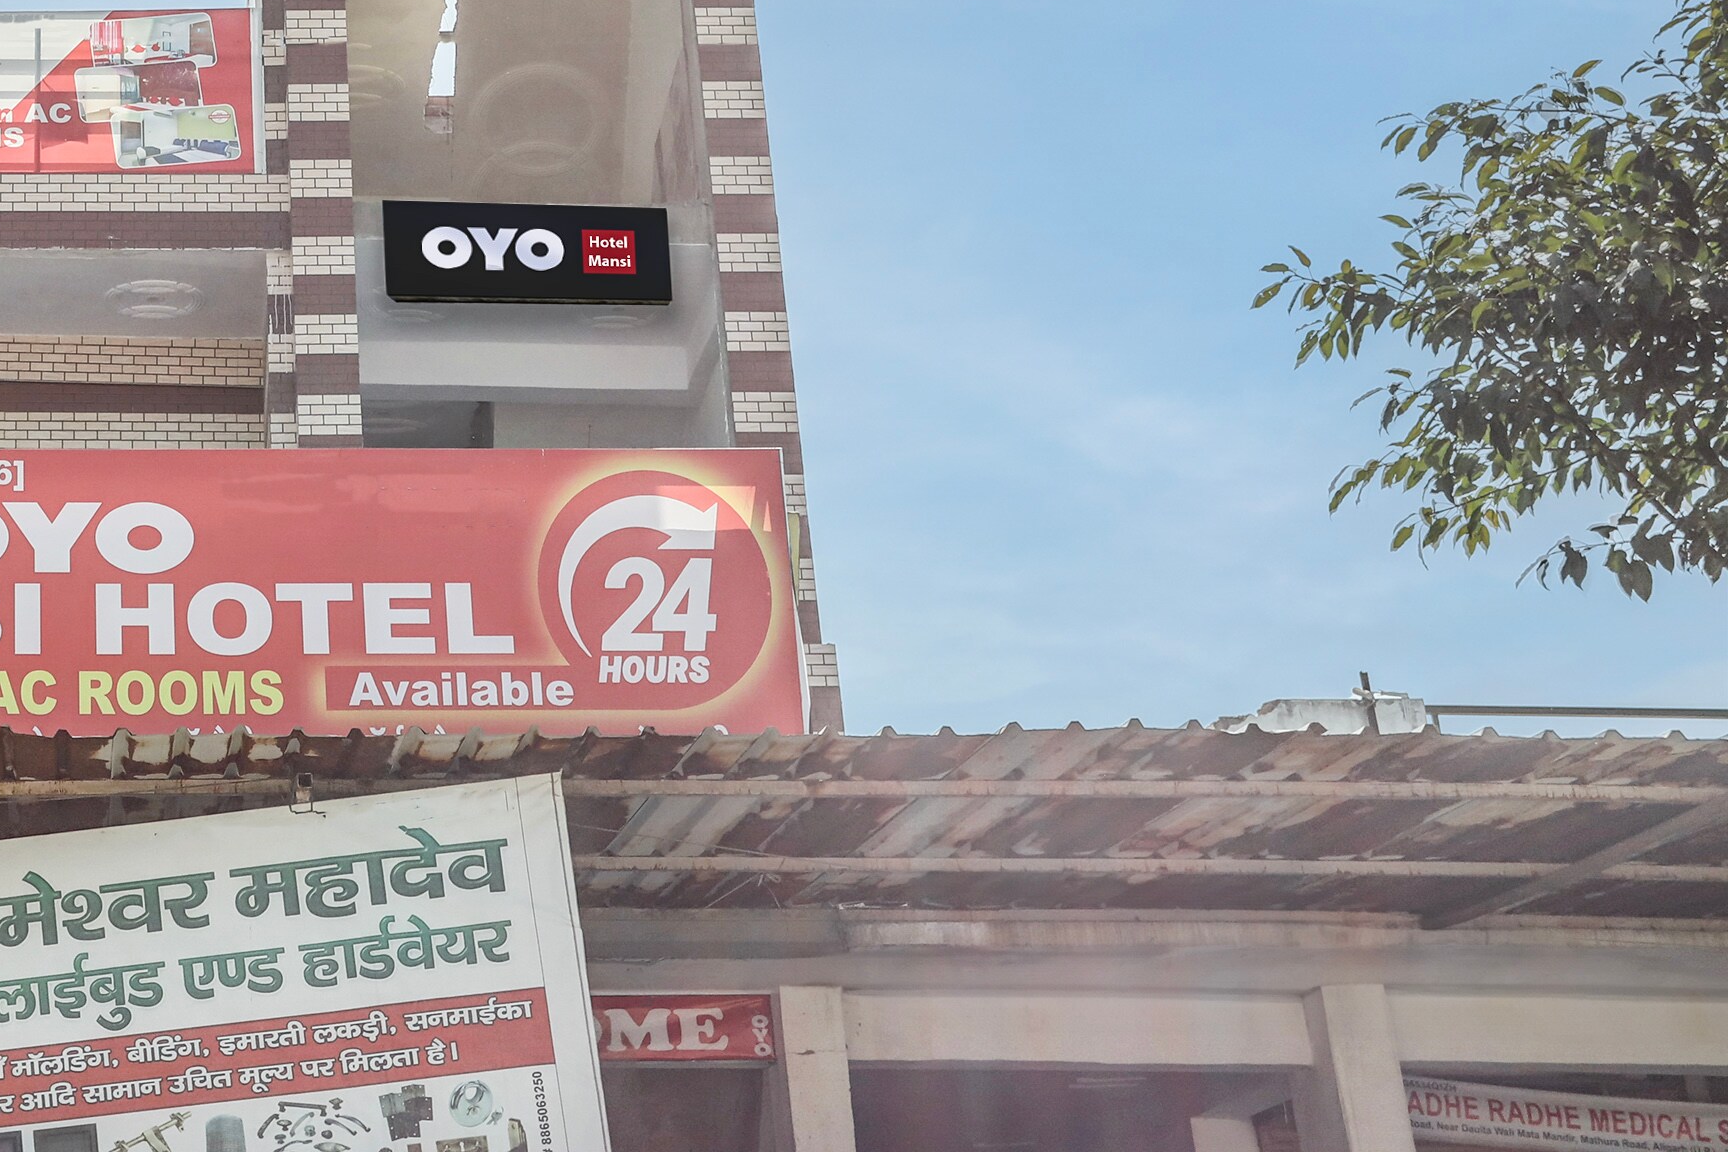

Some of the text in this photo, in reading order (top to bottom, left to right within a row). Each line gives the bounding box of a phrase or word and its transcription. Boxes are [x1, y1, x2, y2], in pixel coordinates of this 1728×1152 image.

[24, 103, 72, 124] AC
[421, 226, 565, 271] OYO
[588, 254, 631, 268] Mansi
[589, 235, 628, 250] Hotel
[95, 581, 515, 657] HOTEL
[600, 556, 717, 652] 24
[348, 671, 575, 707] Available
[598, 655, 711, 684] HOURS
[77, 670, 284, 716] ROOMS
[229, 825, 508, 918] महादेव
[178, 947, 285, 1000] एण्ड
[298, 913, 512, 988] हार्डवेयर
[10, 1044, 120, 1078] मॉलडिंग,
[126, 1035, 210, 1064] बीडिंग,
[216, 1023, 306, 1057] इमारती
[312, 1011, 397, 1045] लकड़ी,
[403, 997, 534, 1032] सनमाईका
[751, 1014, 771, 1056] OYO
[19, 1081, 77, 1111] आदि
[82, 1077, 162, 1105] सामान
[167, 1062, 233, 1095] उचित
[238, 1062, 295, 1094] मूल्य
[299, 1058, 336, 1079] पर
[339, 1048, 420, 1075] मिलता
[531, 1071, 552, 1145] 8865063250
[1437, 1122, 1459, 1131] Near
[1487, 1099, 1581, 1130] RADHE
[1588, 1108, 1711, 1143] MEDICAL
